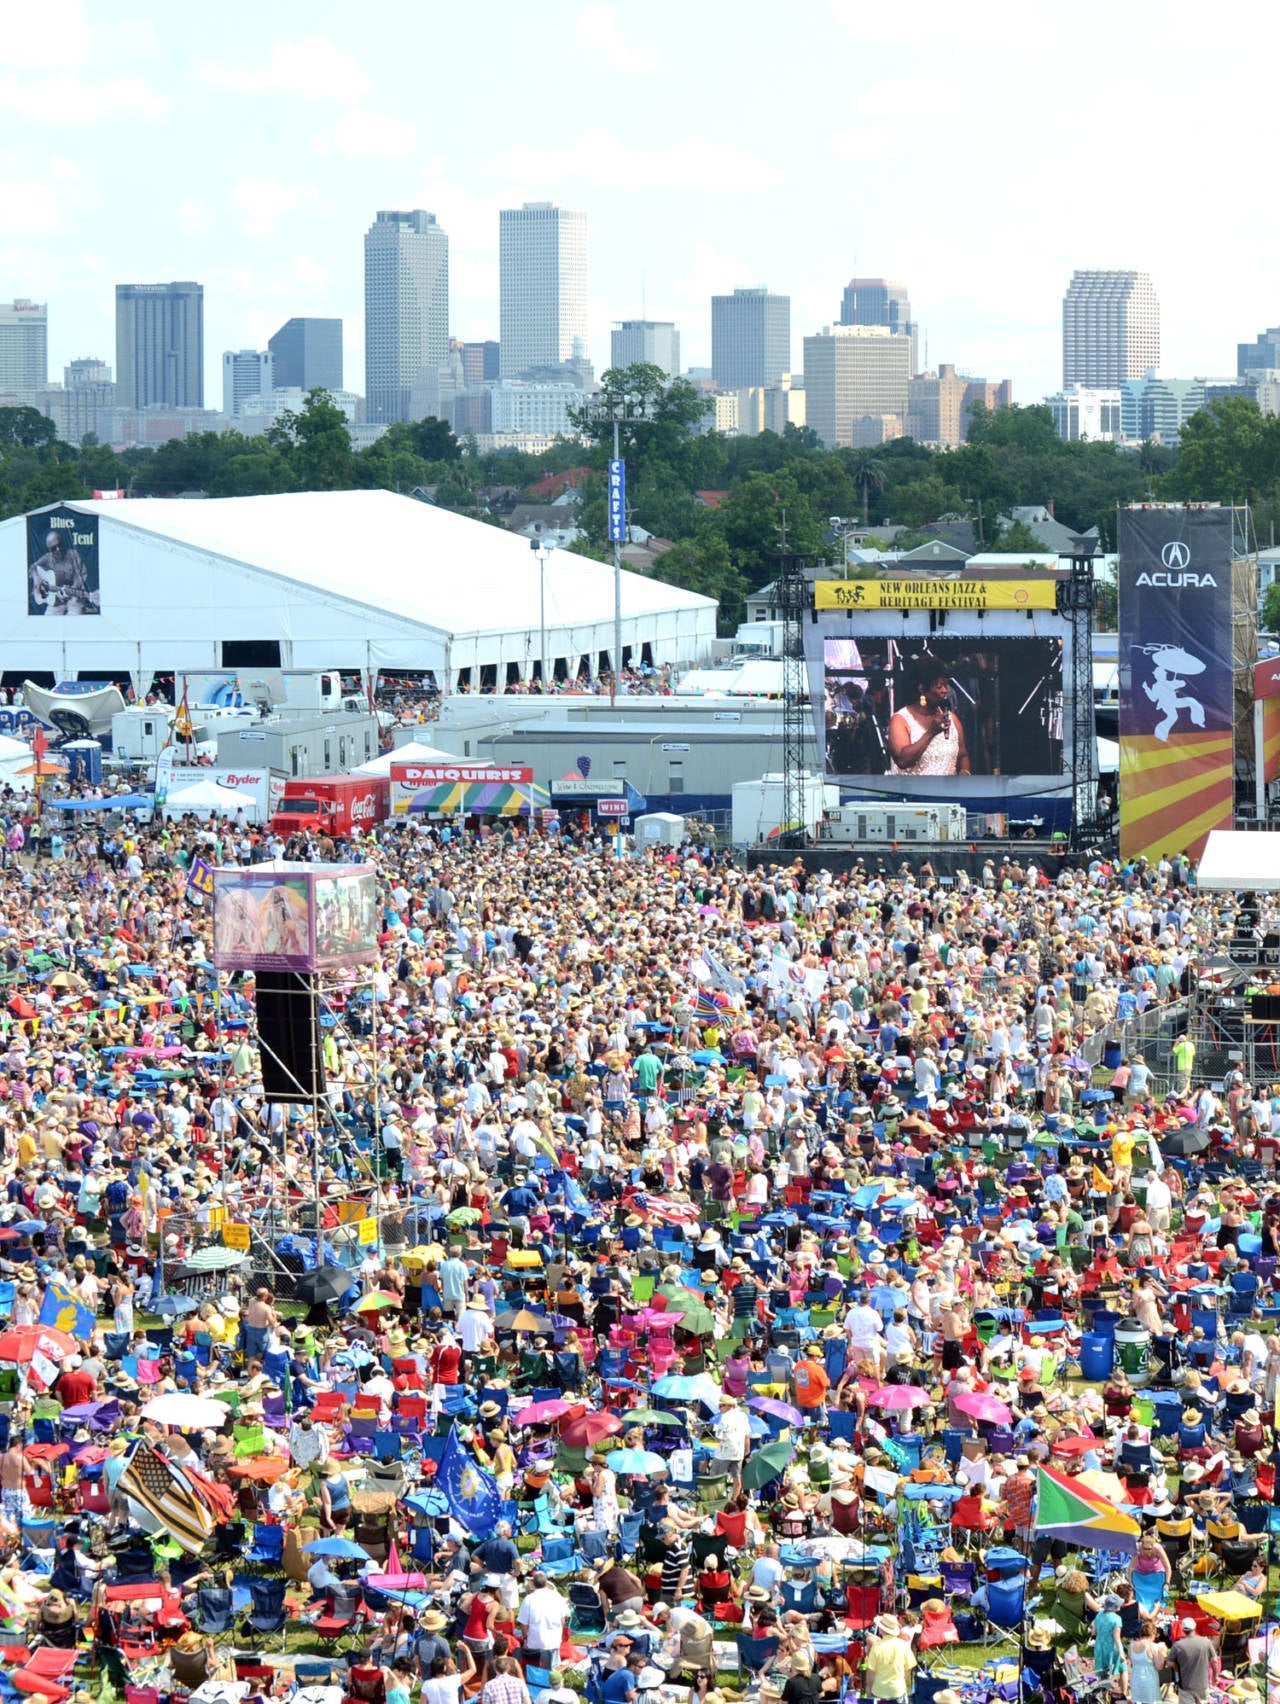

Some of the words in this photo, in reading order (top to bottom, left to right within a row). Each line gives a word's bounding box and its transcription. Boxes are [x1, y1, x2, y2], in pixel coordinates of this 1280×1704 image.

[611, 461, 621, 539] CRAFTS
[50, 517, 75, 529] Blues
[72, 532, 94, 545] Tent
[1136, 572, 1218, 588] ACURA
[880, 582, 900, 594] NEW
[904, 582, 950, 594] ORLEANS
[953, 582, 977, 595] JAZZ
[979, 584, 987, 594] &
[879, 596, 935, 608] HERITAGE
[944, 596, 988, 608] FESTIVAL
[226, 774, 262, 786] Ryder
[405, 769, 522, 781] DAIQUIRIS
[600, 803, 626, 812] WINE
